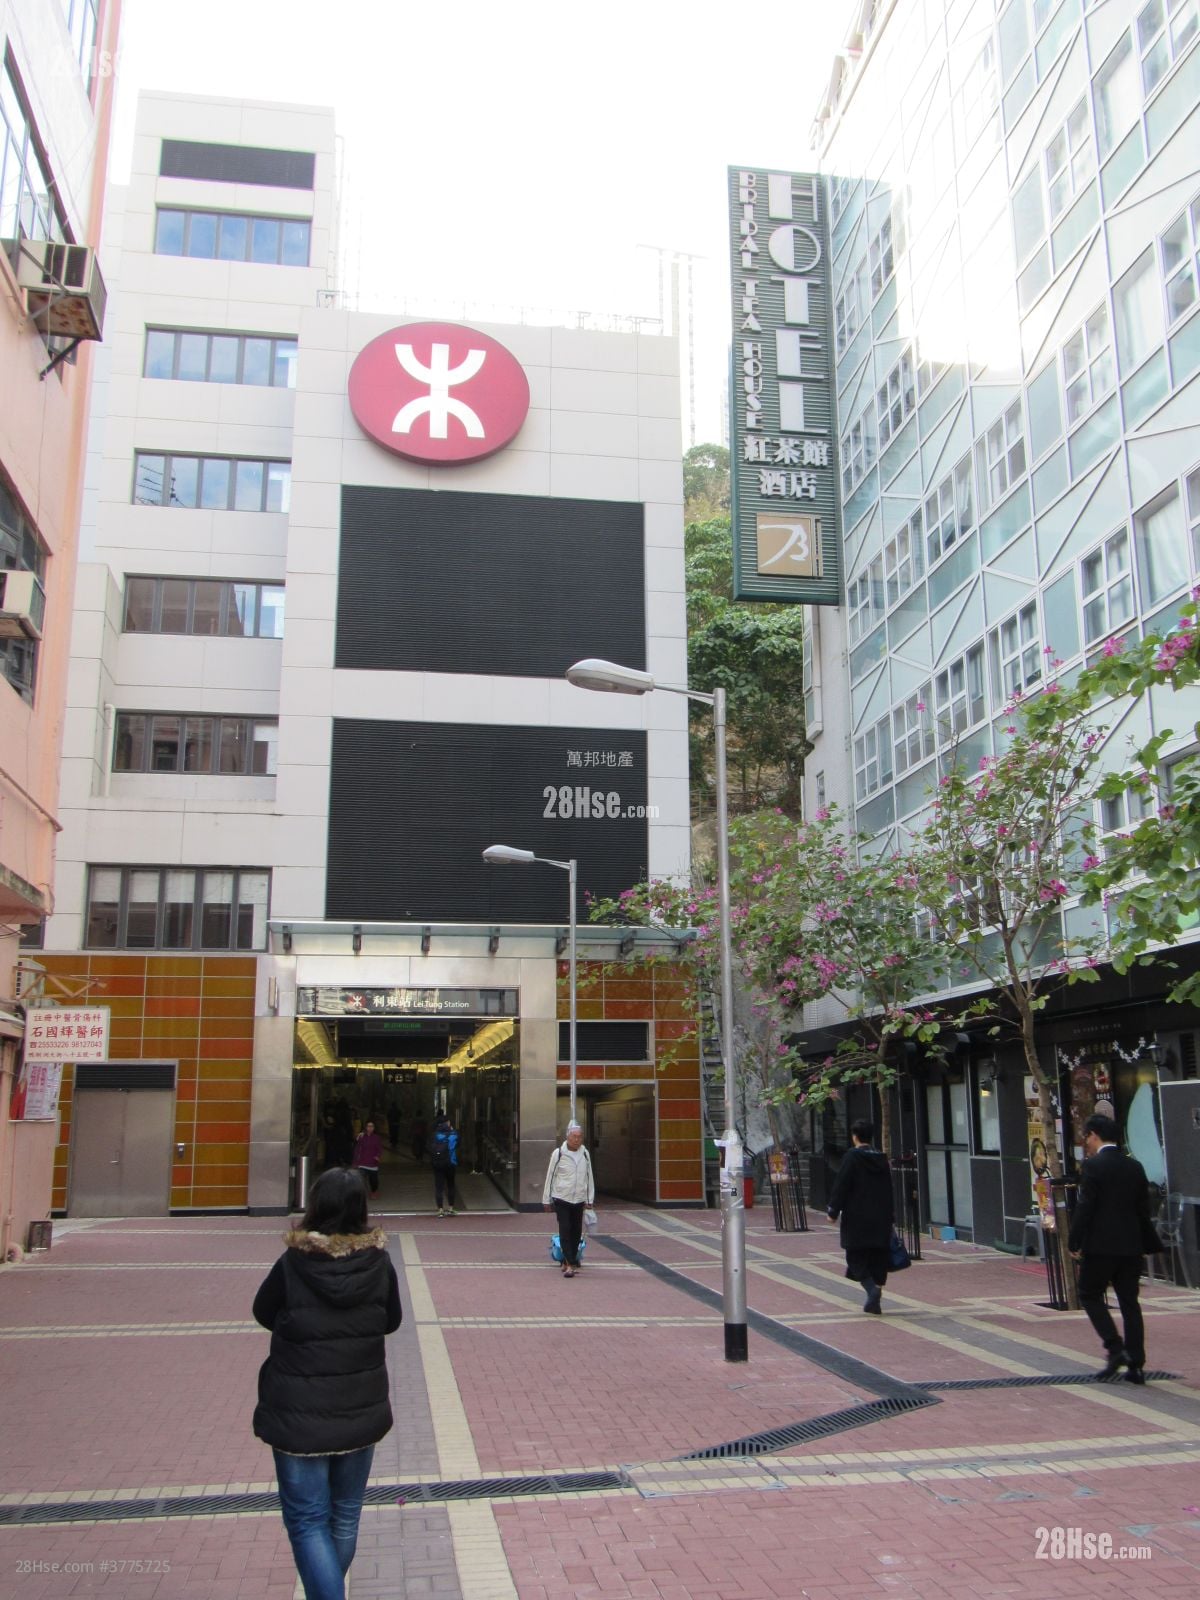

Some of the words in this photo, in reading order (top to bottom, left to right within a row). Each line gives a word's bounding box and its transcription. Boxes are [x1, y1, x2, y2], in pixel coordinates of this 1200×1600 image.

[738, 171, 760, 270] BRIDAL
[740, 280, 762, 332] TEA
[767, 174, 829, 434] HOTEL
[743, 341, 763, 431] HOUSE
[743, 435, 829, 466] 紅茶館
[758, 469, 817, 498] 酒店
[373, 995, 411, 1008] 利東站
[413, 1000, 423, 1008] Lei
[424, 1000, 442, 1010] Tung
[444, 1000, 470, 1008] Station
[32, 1025, 103, 1039] 石國輝醫師
